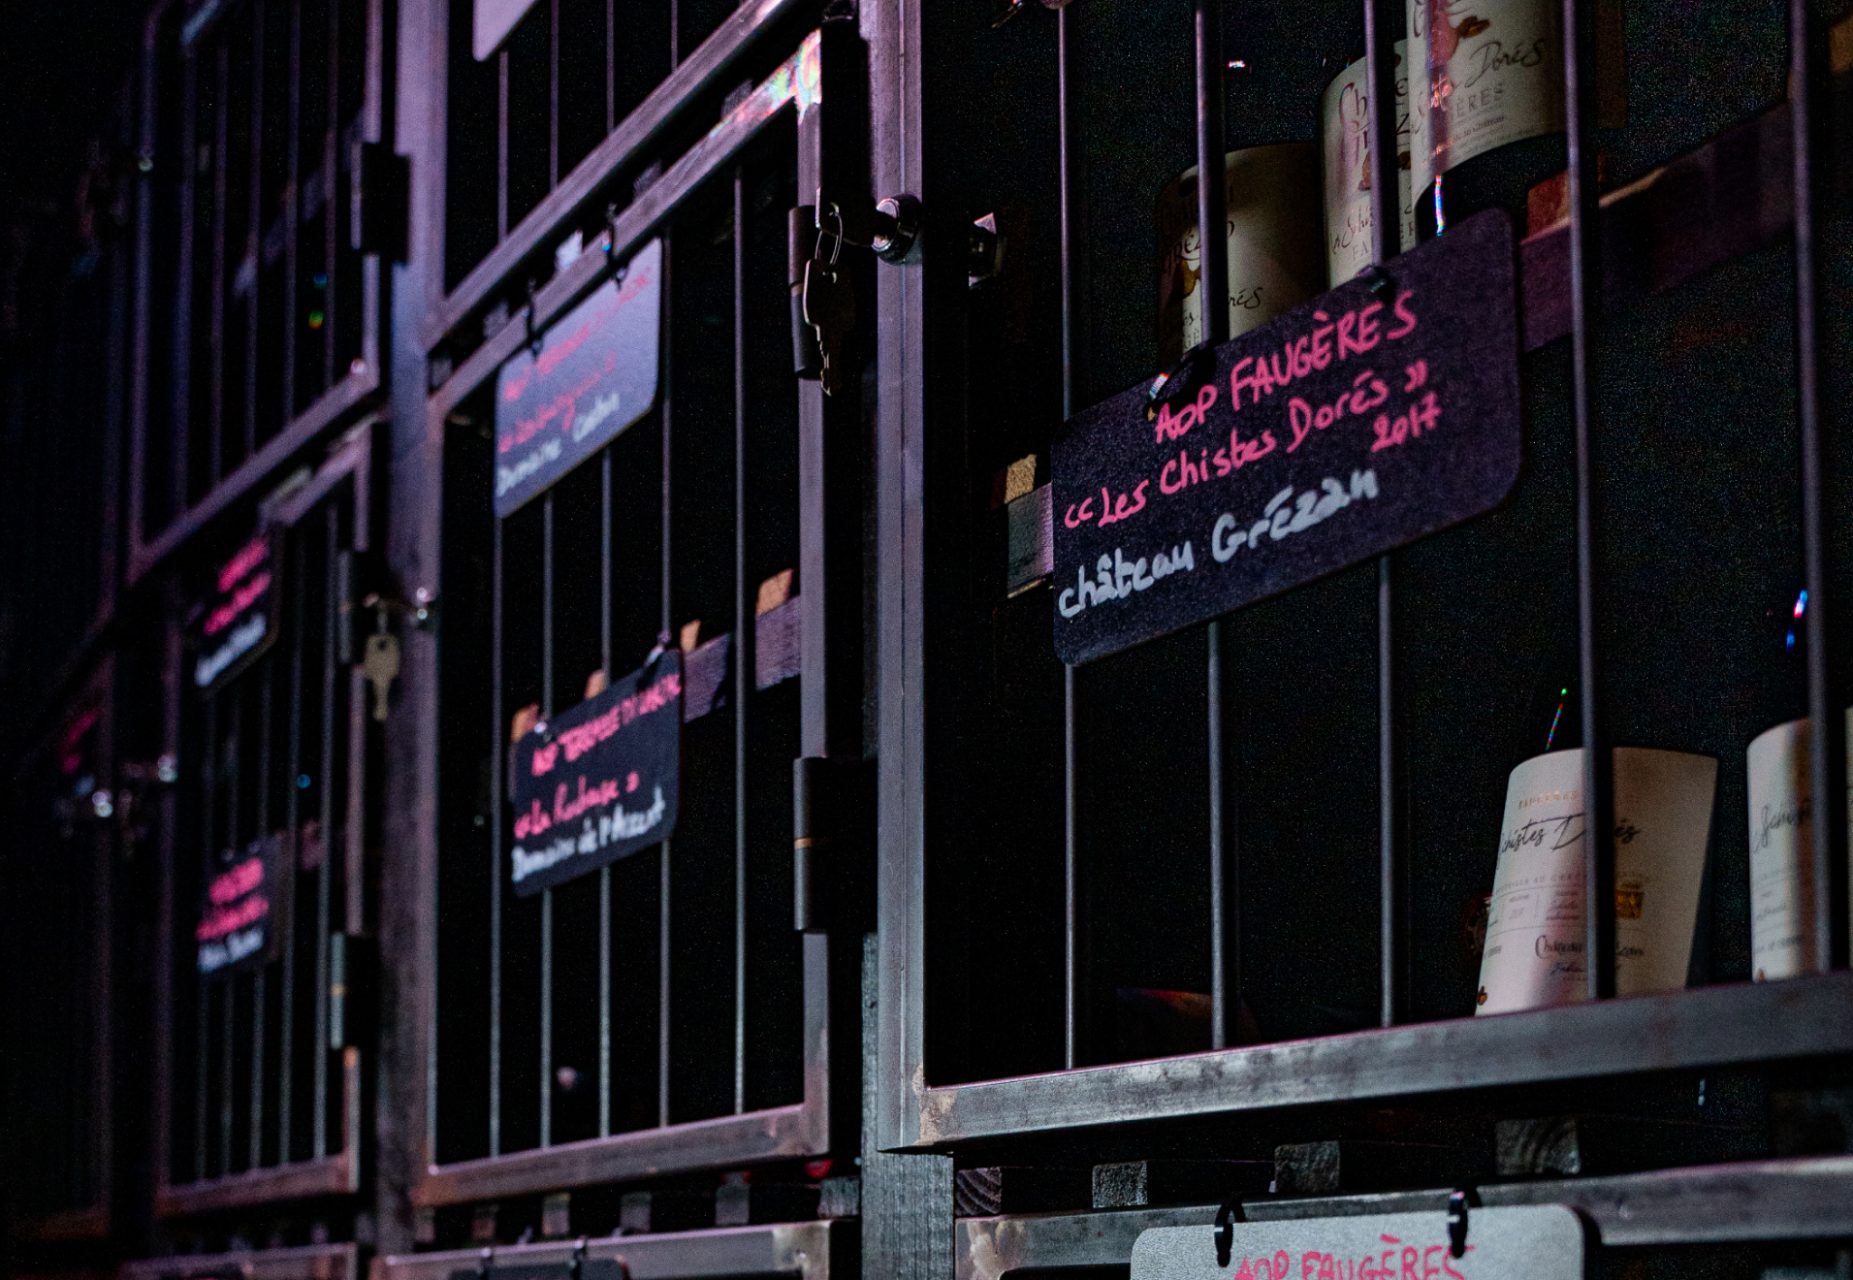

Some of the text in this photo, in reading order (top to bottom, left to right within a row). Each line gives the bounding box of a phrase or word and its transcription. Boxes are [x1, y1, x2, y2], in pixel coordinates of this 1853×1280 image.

[1155, 289, 1418, 444] AOP FAUGÈRES
[1371, 391, 1443, 453] 2017
[1160, 426, 1277, 496] Chistes
[1287, 369, 1390, 453] Dorés
[1212, 467, 1380, 566] Grézan
